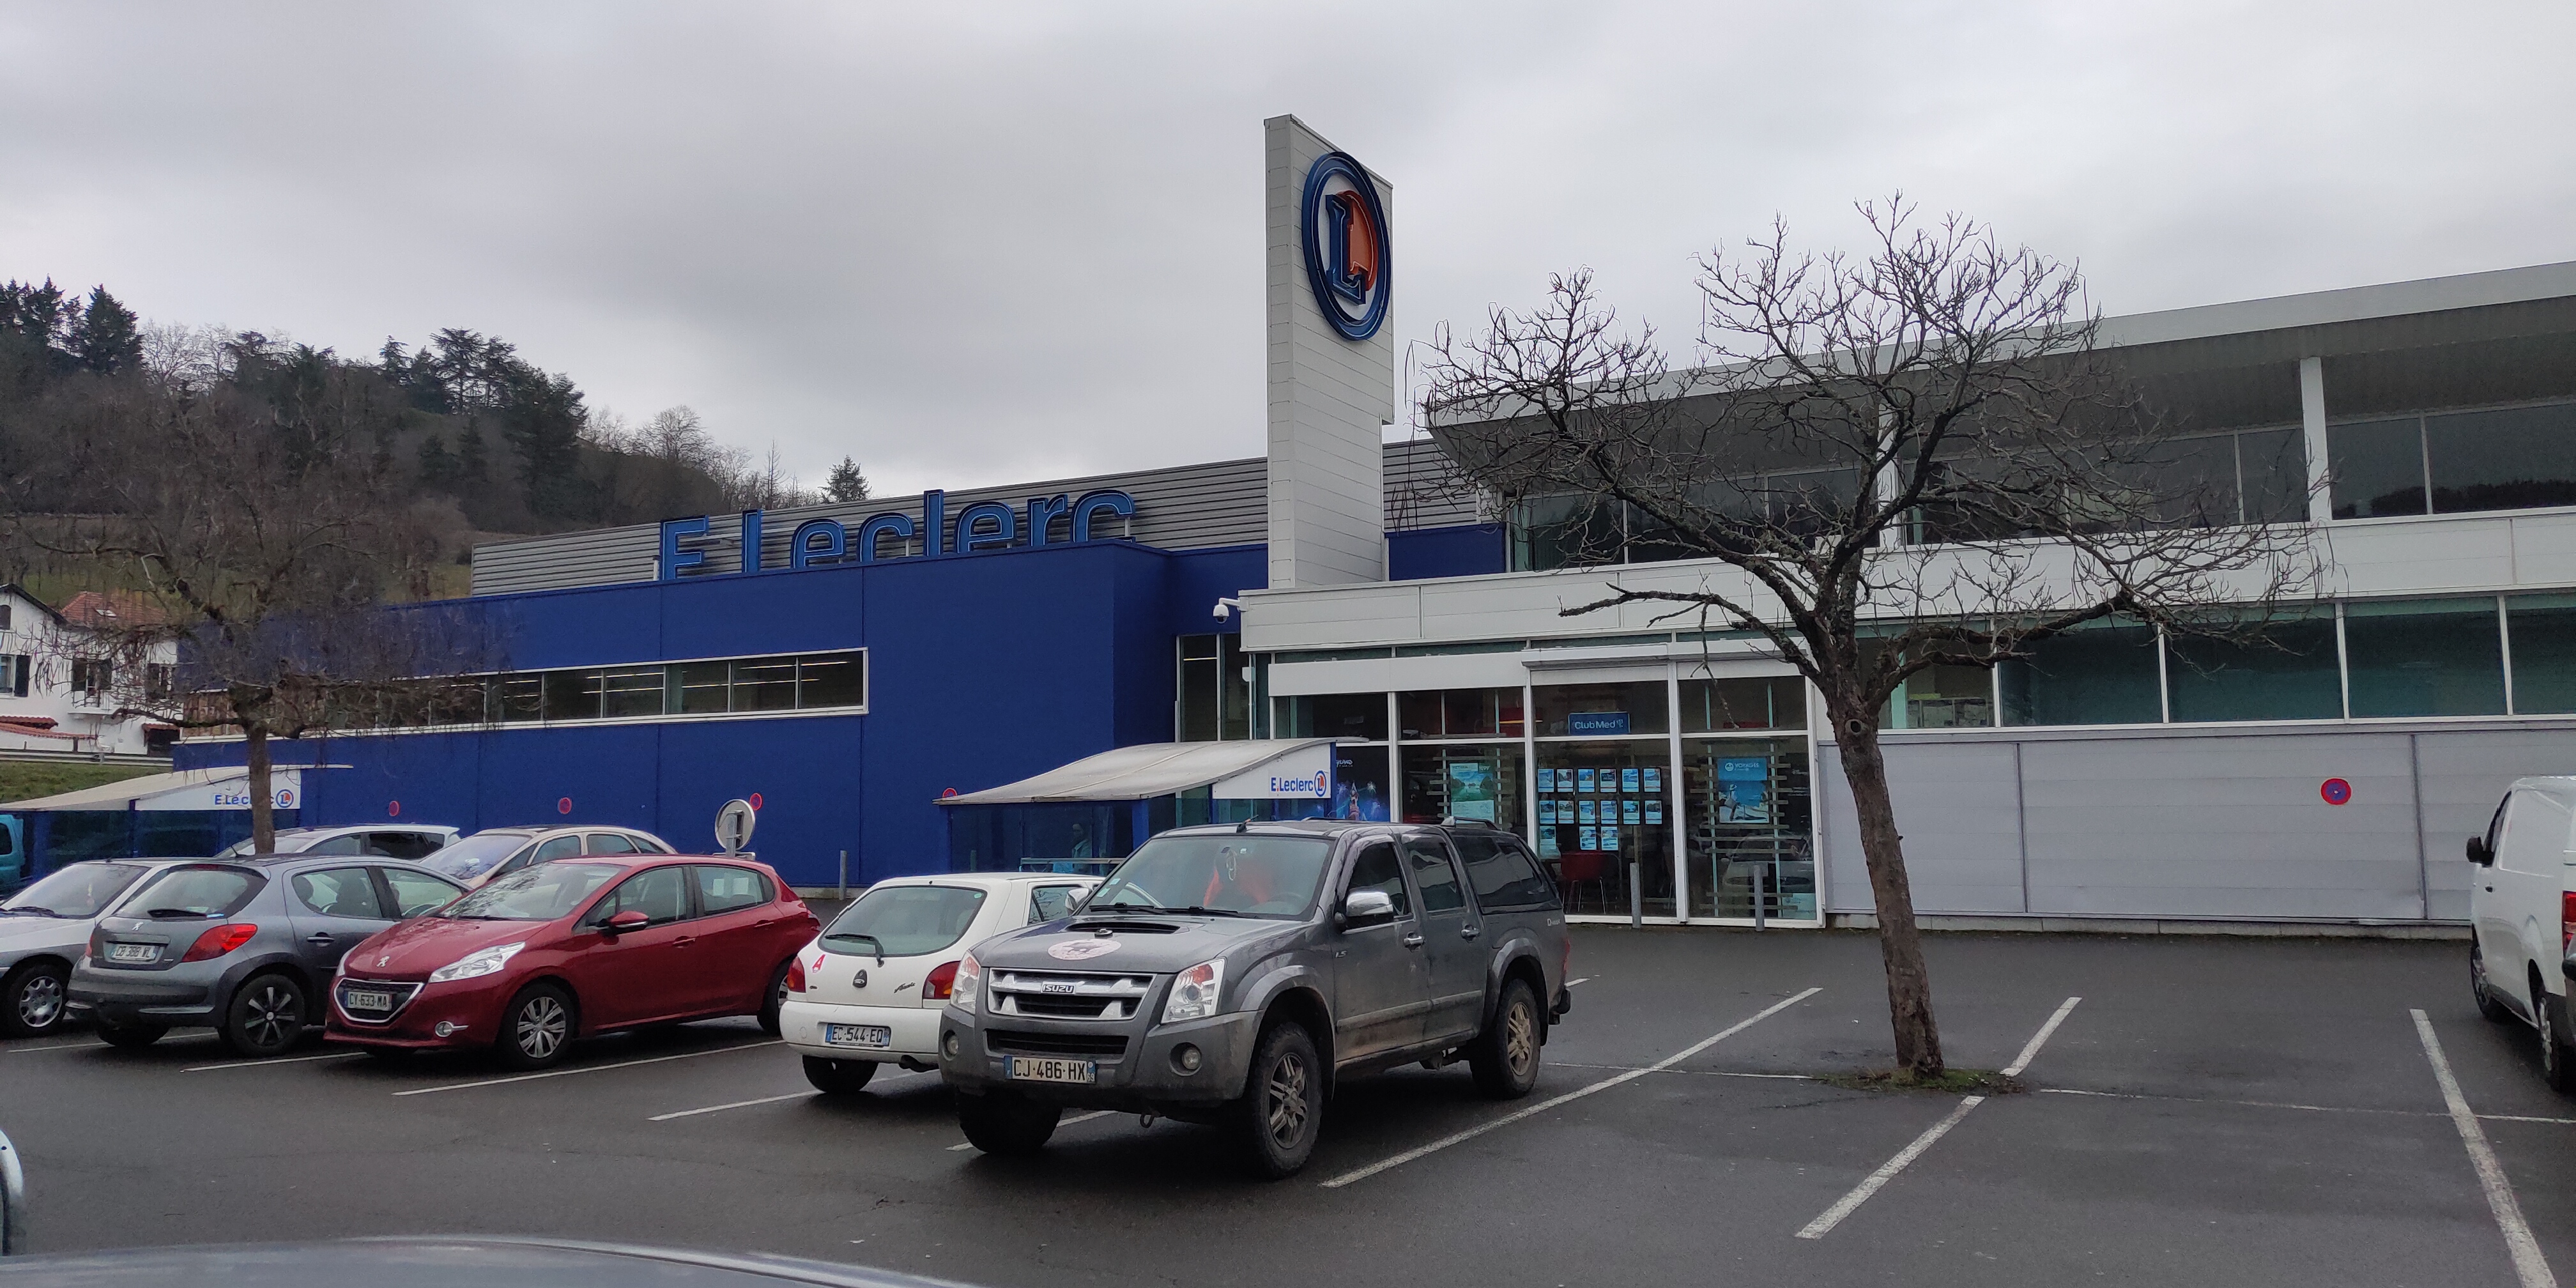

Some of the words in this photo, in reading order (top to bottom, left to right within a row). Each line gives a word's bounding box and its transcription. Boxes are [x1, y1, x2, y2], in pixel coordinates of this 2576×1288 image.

[1325, 194, 1367, 305] L
[659, 489, 1137, 581] ELeclerc
[1574, 721, 1595, 729] Club
[1596, 720, 1615, 728] Med
[1271, 777, 1314, 792] E.Leclerc
[1043, 984, 1074, 993] ISUZU
